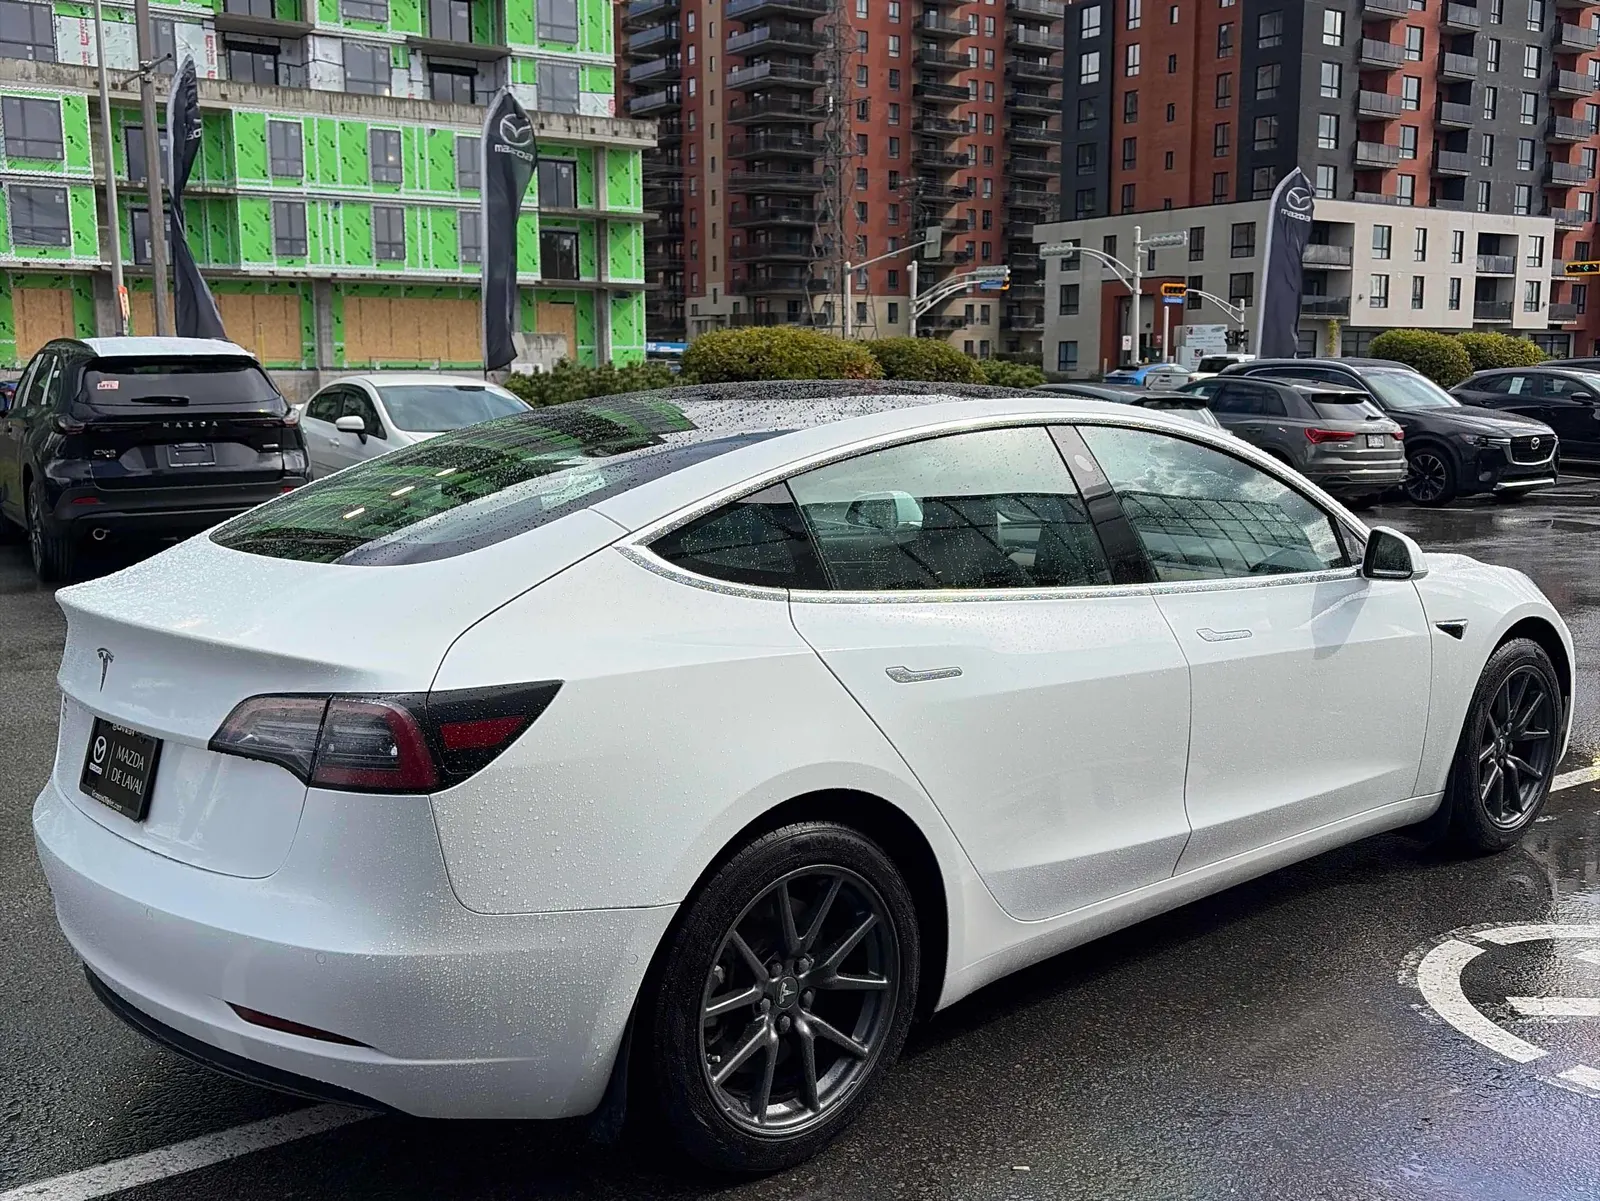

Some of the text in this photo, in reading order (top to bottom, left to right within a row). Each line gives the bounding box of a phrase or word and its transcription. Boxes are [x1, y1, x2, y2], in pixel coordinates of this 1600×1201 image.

[1280, 208, 1311, 222] mazda
[162, 421, 219, 429] MAZDA
[116, 745, 145, 771] MAZDA
[111, 767, 122, 785] DE
[121, 772, 143, 795] LAVAL
